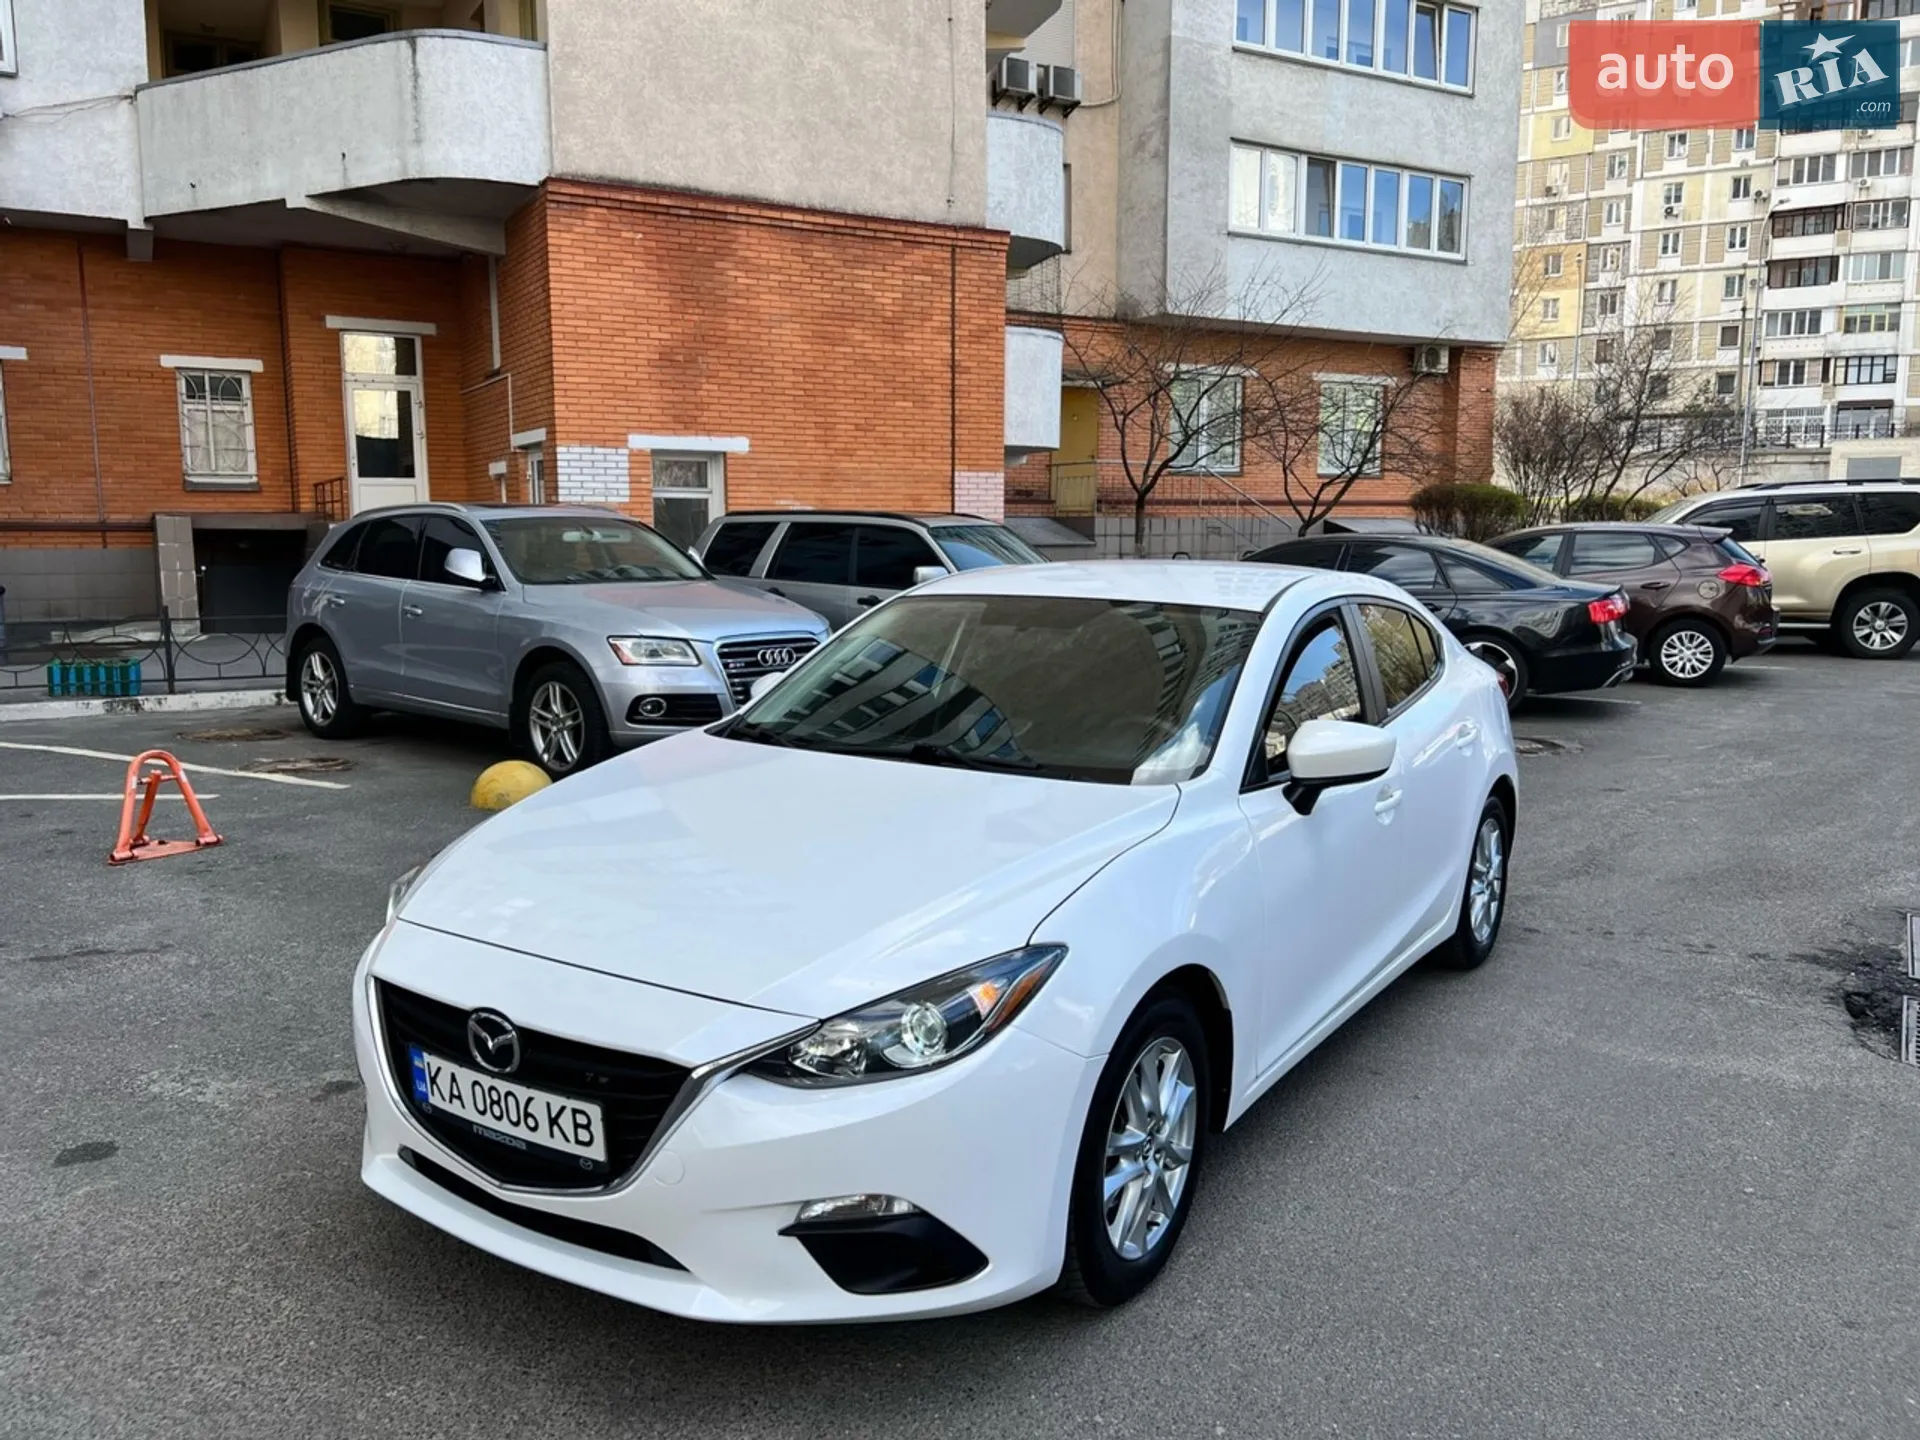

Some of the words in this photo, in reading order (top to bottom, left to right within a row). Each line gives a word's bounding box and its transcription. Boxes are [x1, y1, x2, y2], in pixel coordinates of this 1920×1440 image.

[426, 1062, 467, 1110] KA
[471, 1080, 539, 1133] 0806
[545, 1101, 595, 1148] KB
